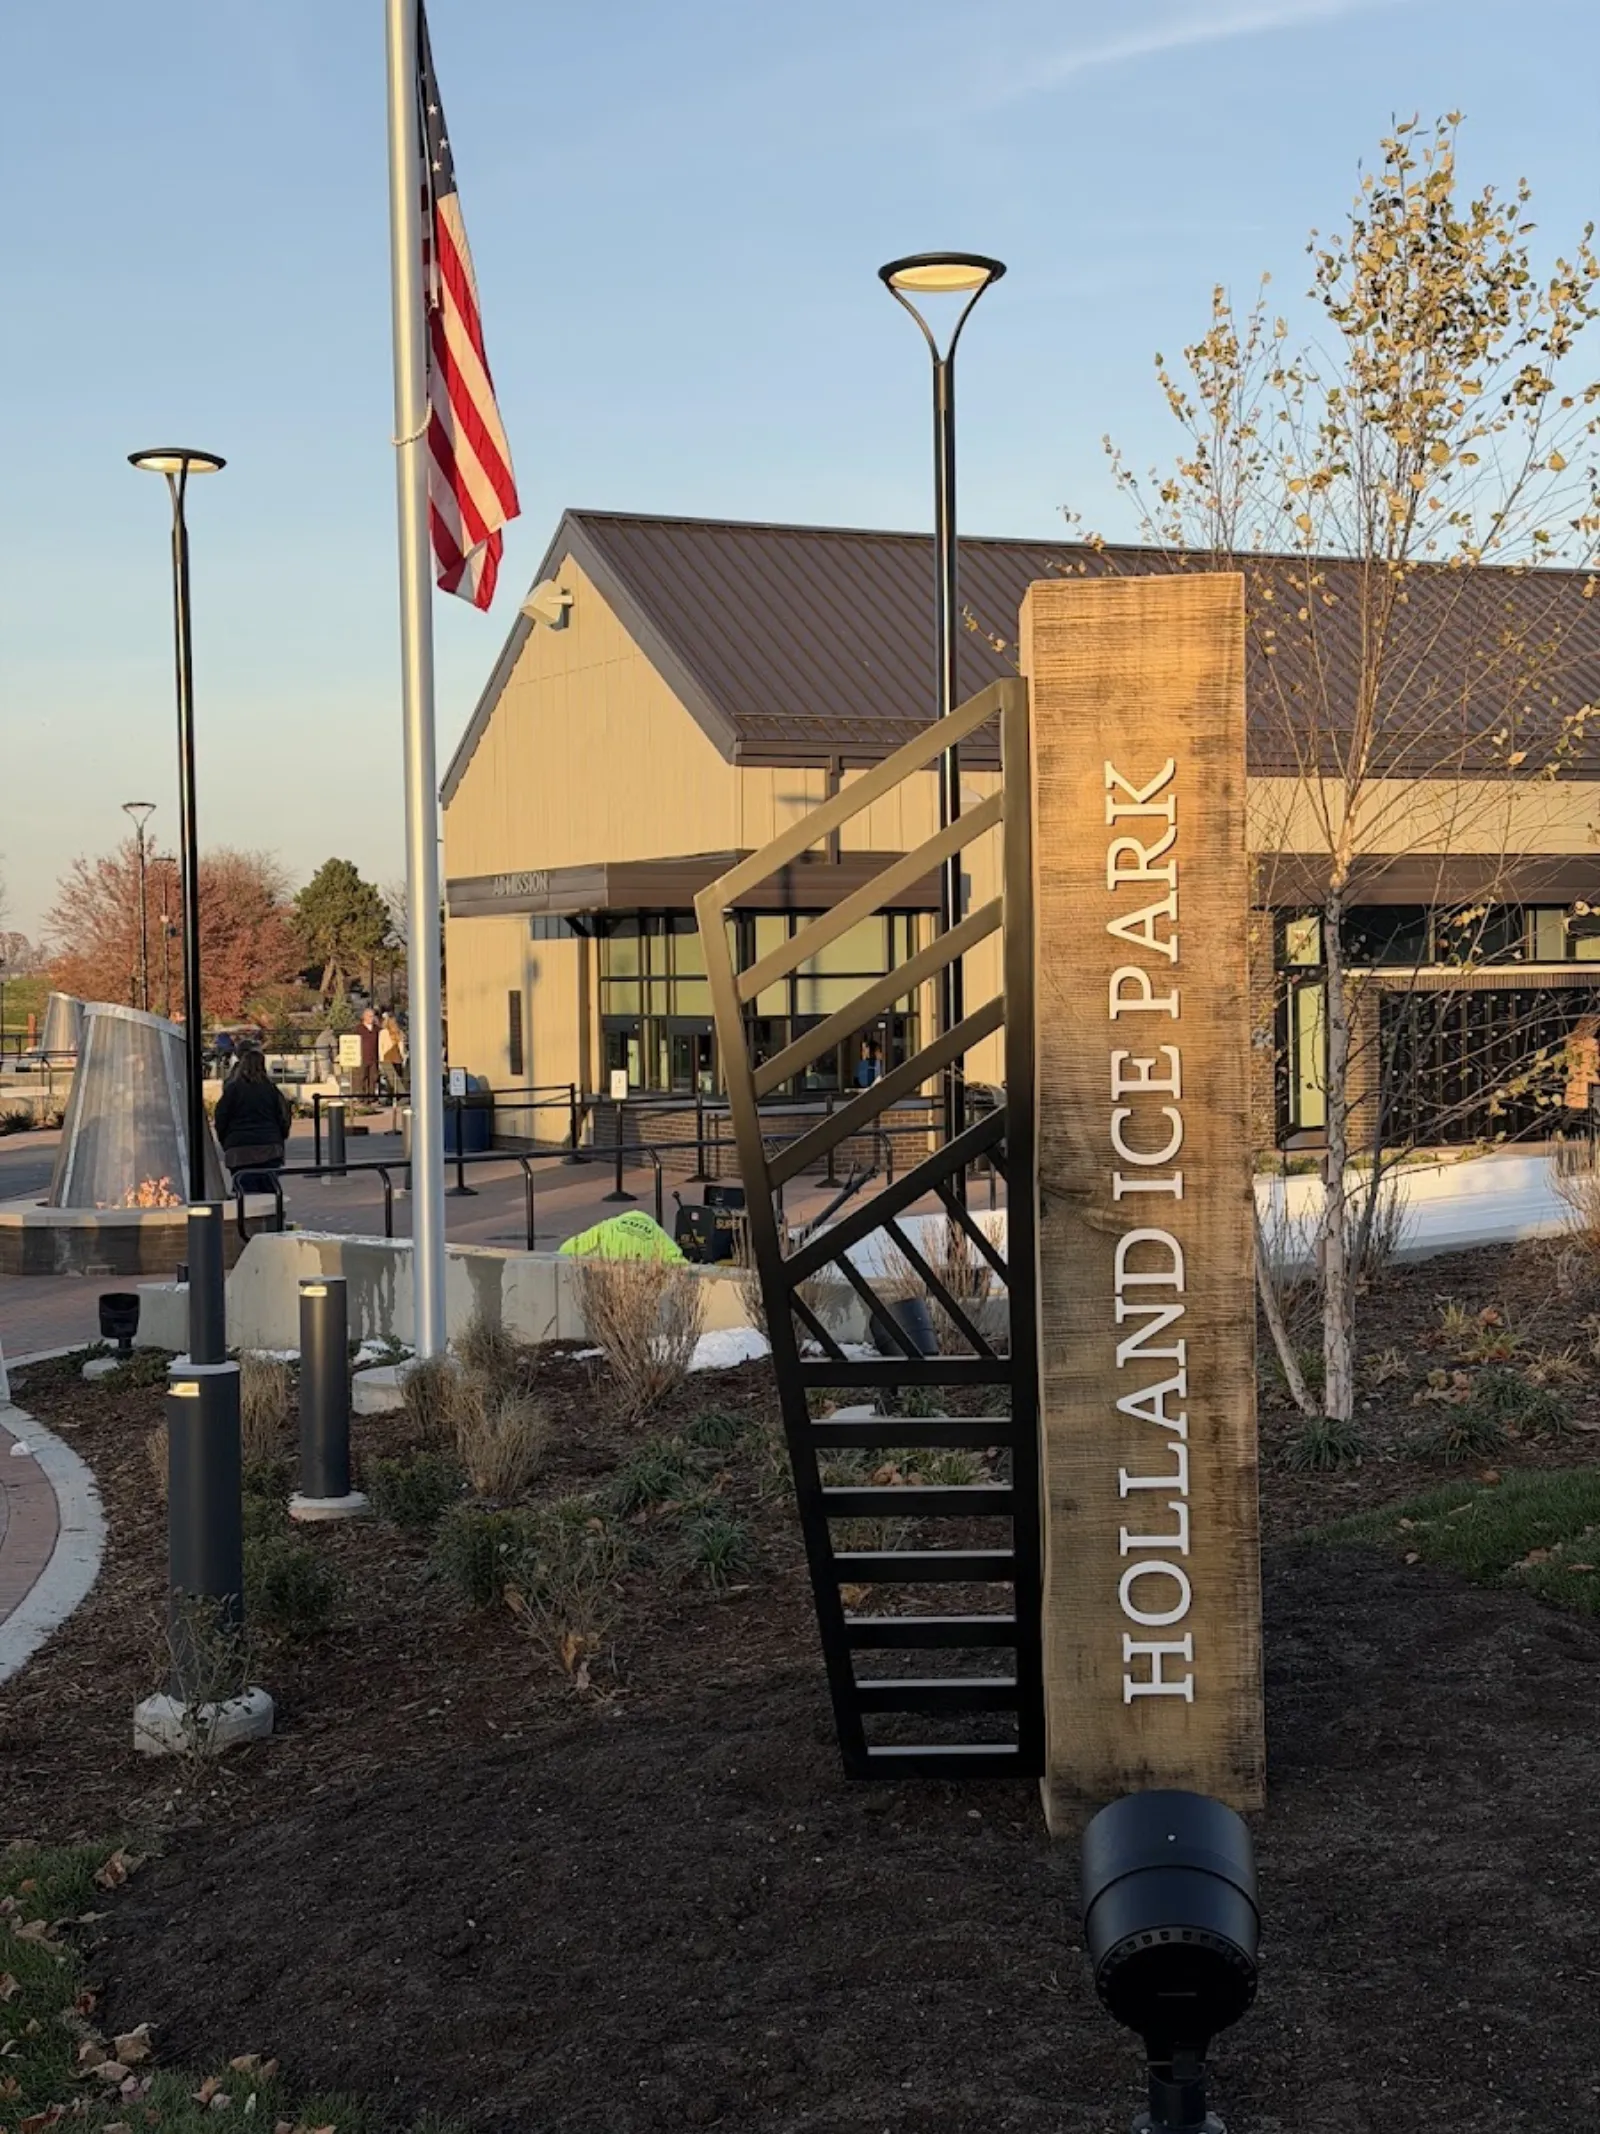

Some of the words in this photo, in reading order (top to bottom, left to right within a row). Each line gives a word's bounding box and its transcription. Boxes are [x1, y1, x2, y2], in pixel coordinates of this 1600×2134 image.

[492, 870, 549, 897] ADMISSION
[1104, 757, 1179, 1020] PARK
[1110, 1045, 1183, 1201] ICE
[1114, 1227, 1193, 1704] HOLLAND
